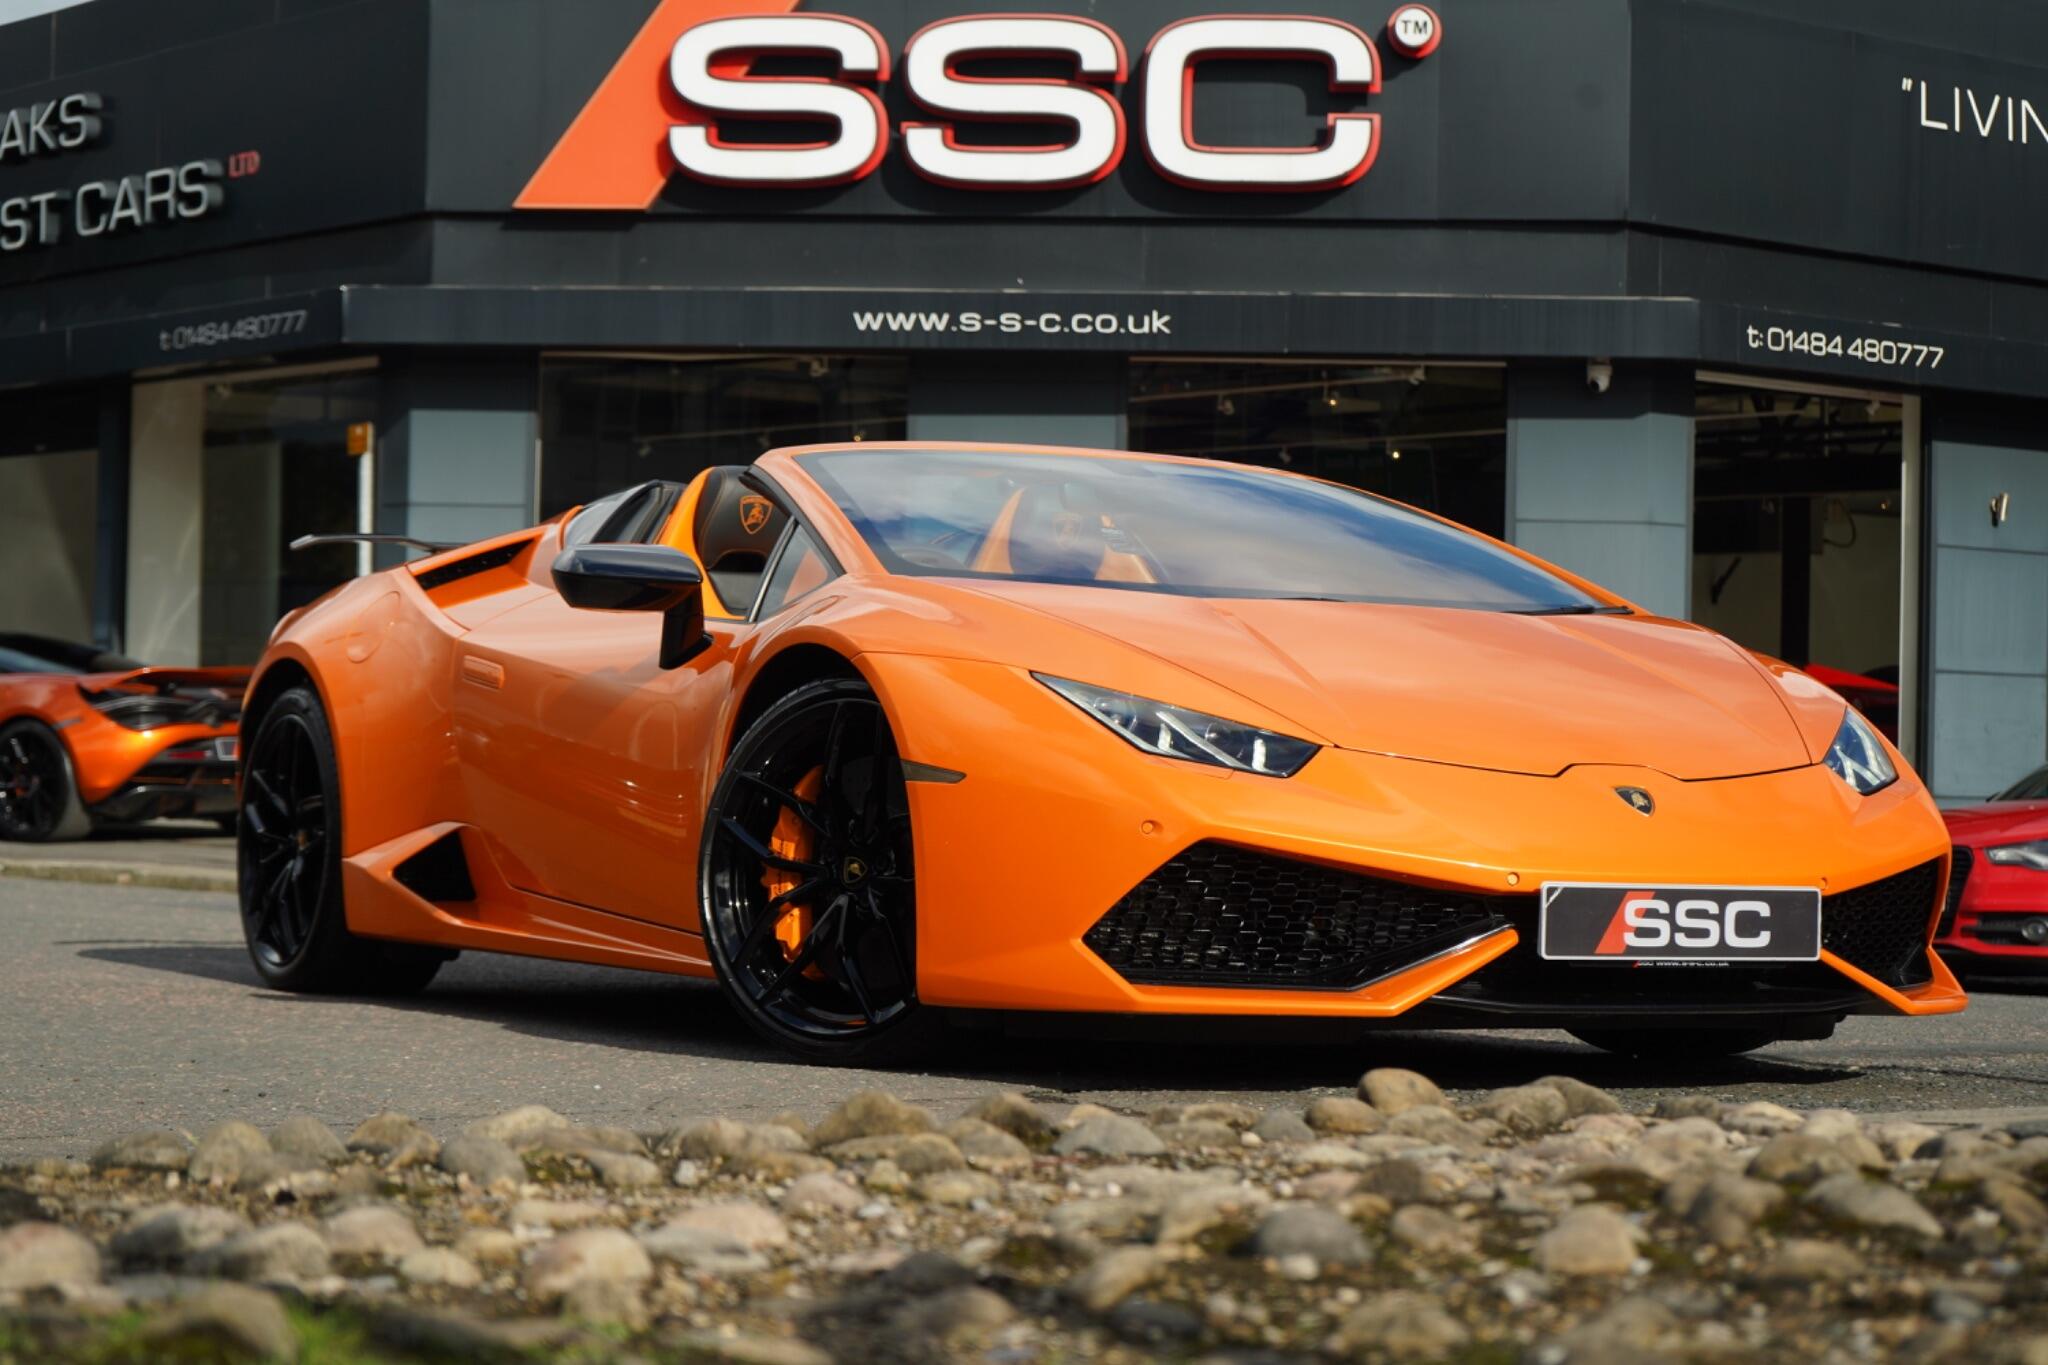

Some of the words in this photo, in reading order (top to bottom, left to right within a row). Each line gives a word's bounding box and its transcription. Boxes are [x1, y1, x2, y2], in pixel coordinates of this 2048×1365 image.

[668, 14, 1378, 187] SSC
[1401, 20, 1428, 35] TM
[0, 92, 92, 160] AKS
[229, 151, 260, 177] LTD
[0, 192, 58, 250] ST
[75, 160, 214, 237] CARS
[853, 310, 1172, 335] www.s-s-c.co.uk
[1767, 327, 1843, 357] 01484
[1847, 337, 1945, 369] 480777
[1623, 899, 1772, 949] SSC
